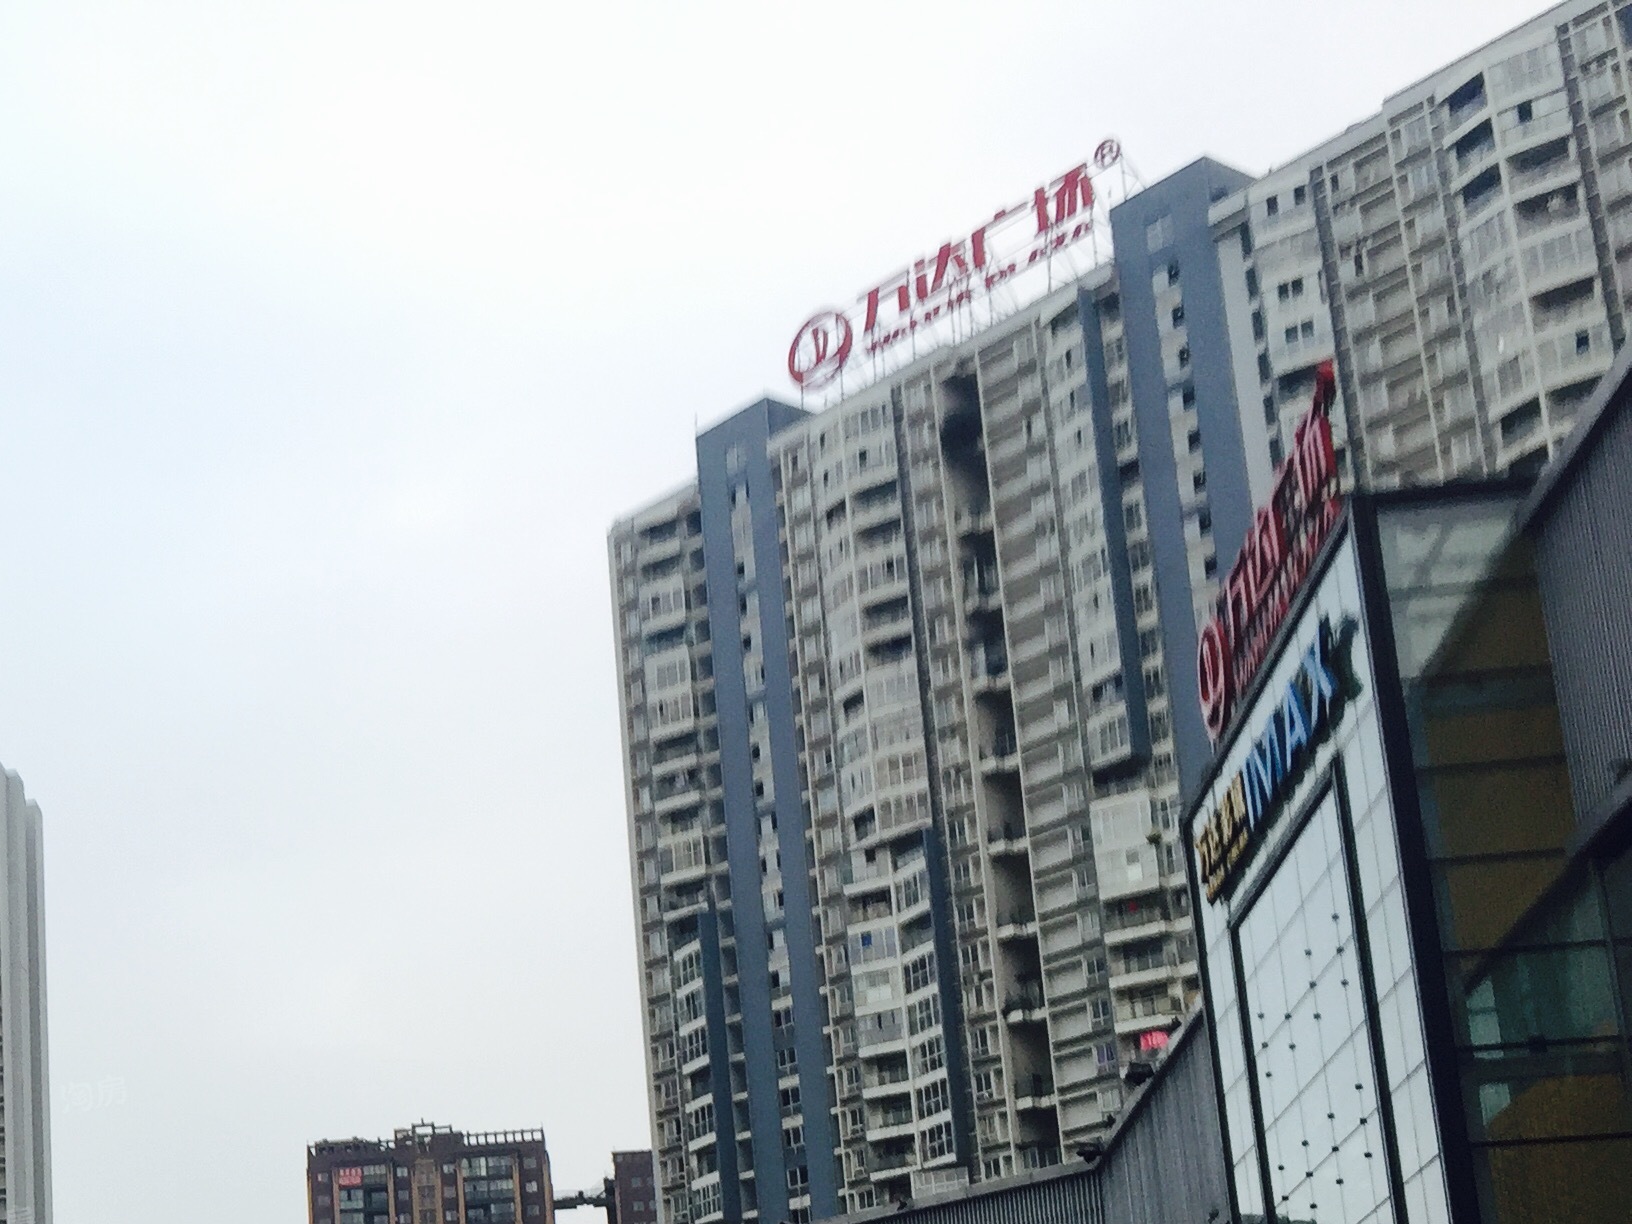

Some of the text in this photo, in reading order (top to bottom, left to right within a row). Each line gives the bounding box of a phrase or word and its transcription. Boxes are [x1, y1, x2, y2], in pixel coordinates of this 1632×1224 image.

[855, 162, 1095, 332] 万达广场
[1242, 632, 1338, 831] IMAX
